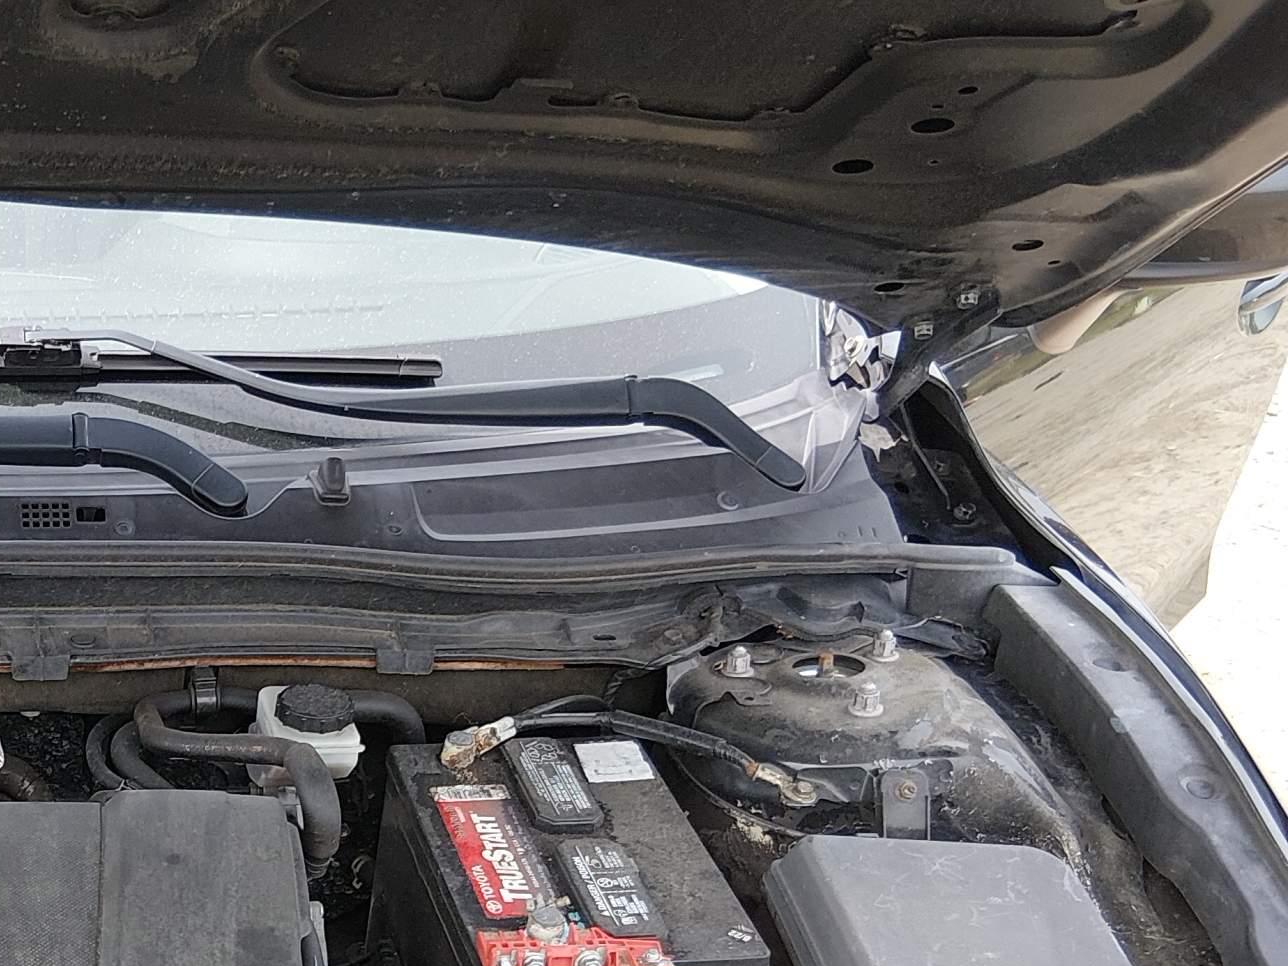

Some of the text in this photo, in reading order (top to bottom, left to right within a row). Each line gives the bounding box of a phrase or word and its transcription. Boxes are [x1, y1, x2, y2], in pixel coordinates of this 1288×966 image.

[470, 811, 532, 902] TRUESTART
[572, 857, 590, 879] POISON
[472, 865, 496, 899] TOYOTA
[587, 884, 607, 910] DANGER
